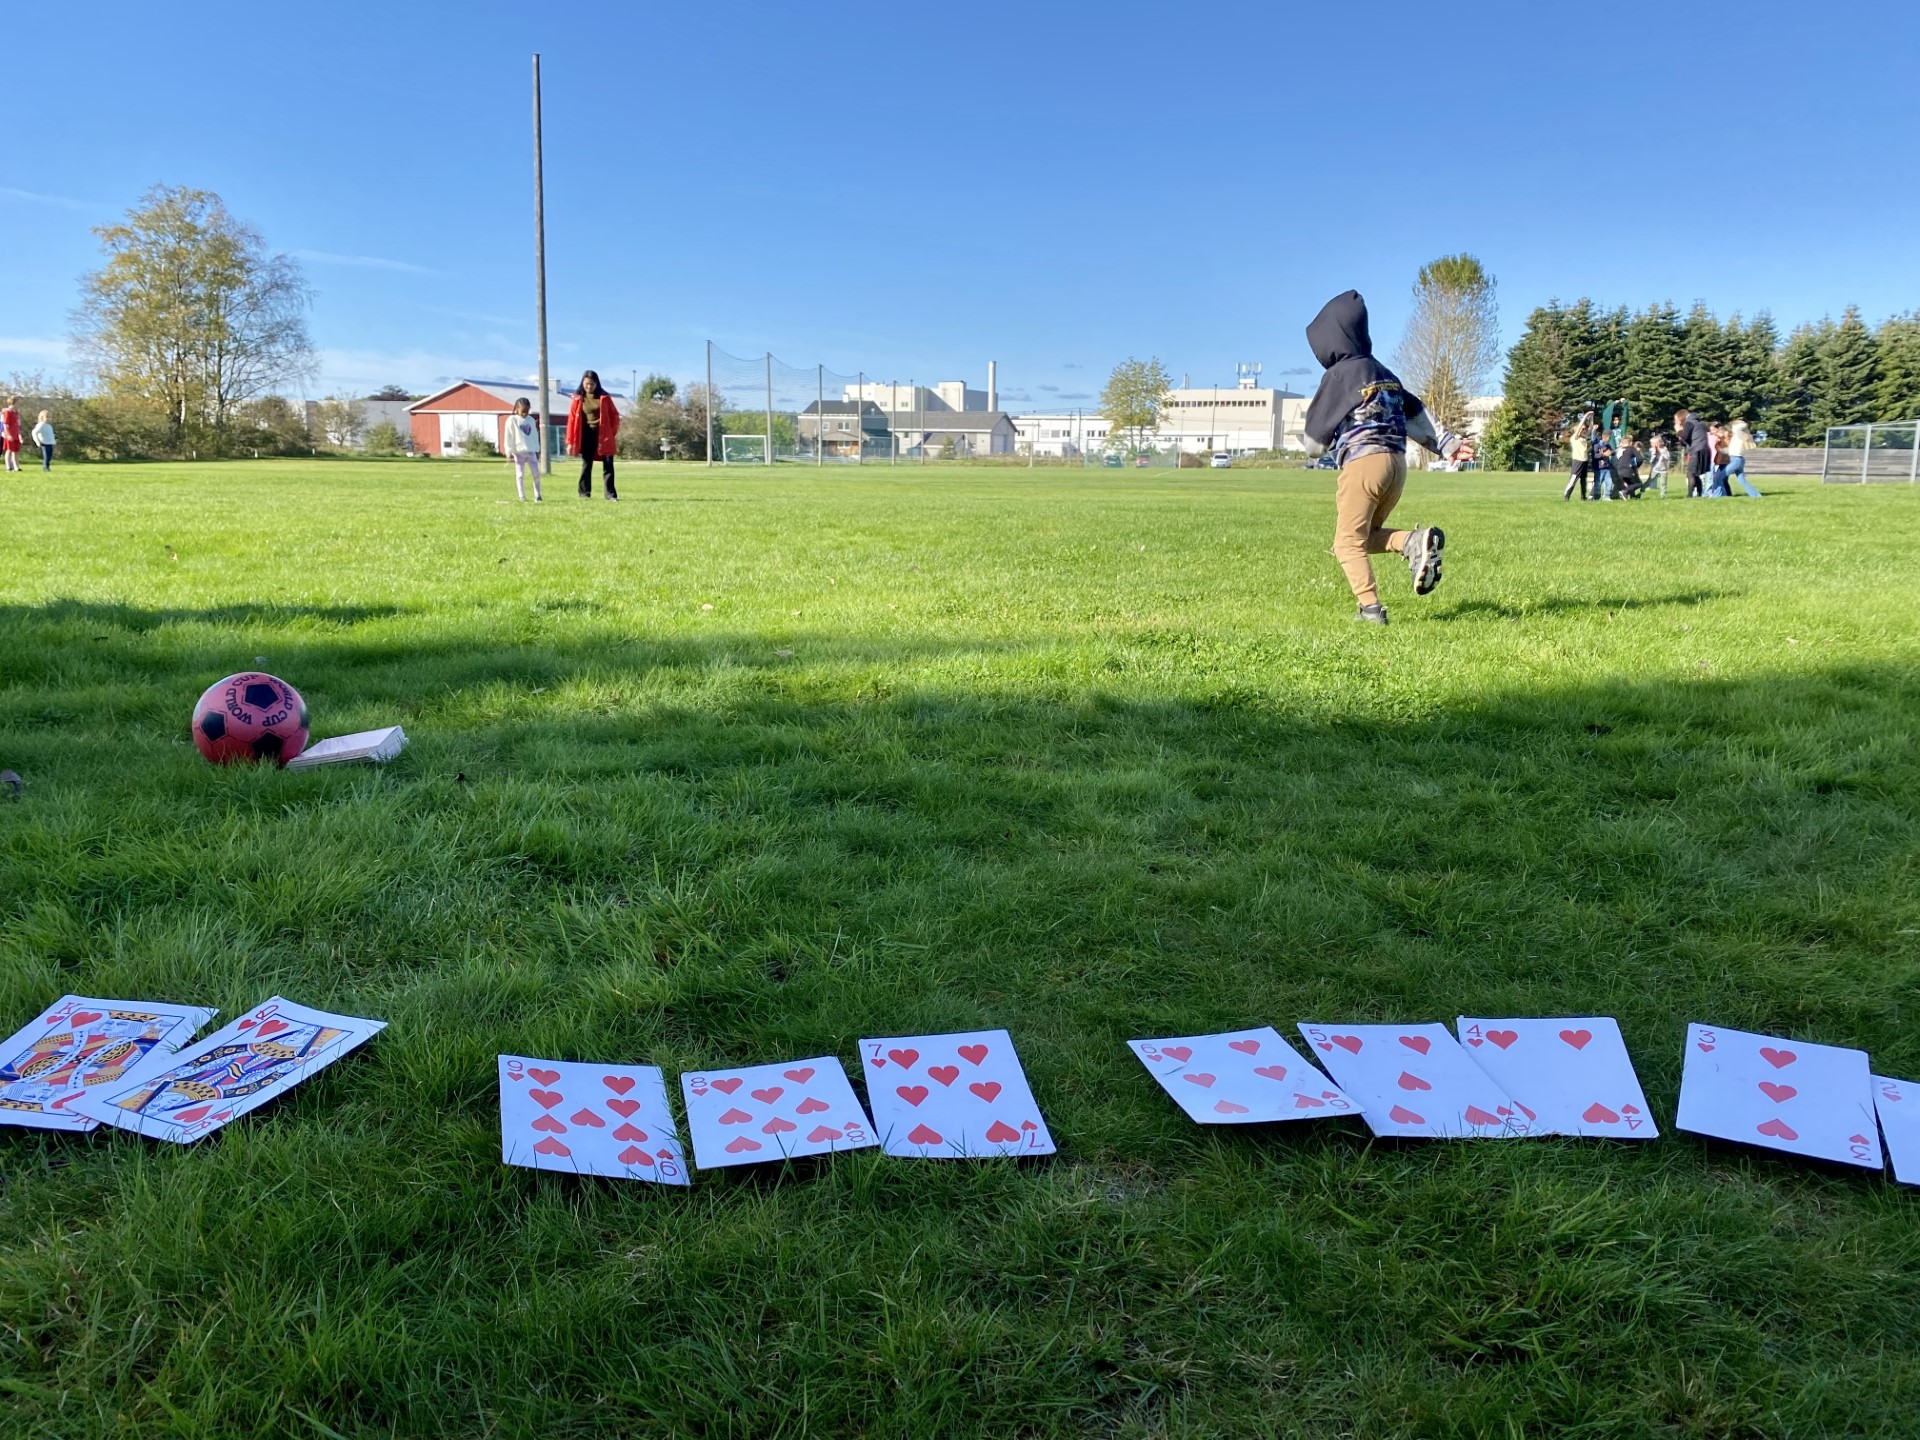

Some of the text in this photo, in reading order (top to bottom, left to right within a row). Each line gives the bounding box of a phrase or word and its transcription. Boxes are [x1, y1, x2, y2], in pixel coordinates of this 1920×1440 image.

[225, 671, 259, 725] WORLD CUP
[262, 676, 293, 727] WORLD CUP
[54, 1002, 83, 1014] K
[255, 1004, 279, 1020] Q
[1309, 1029, 1326, 1041] 5
[1466, 1024, 1482, 1038] 4
[1699, 1029, 1716, 1044] 3
[868, 1044, 882, 1058] 7
[1140, 1043, 1157, 1055] 6
[507, 1060, 523, 1072] 9
[690, 1076, 707, 1089] 8
[1880, 1081, 1899, 1094] 2
[1329, 1098, 1351, 1110] 6
[1506, 1117, 1529, 1131] 5
[1623, 1115, 1643, 1131] 4
[846, 1129, 865, 1142] 8
[1028, 1131, 1045, 1148] 7
[1850, 1145, 1872, 1162] 3
[659, 1159, 678, 1177] 9
